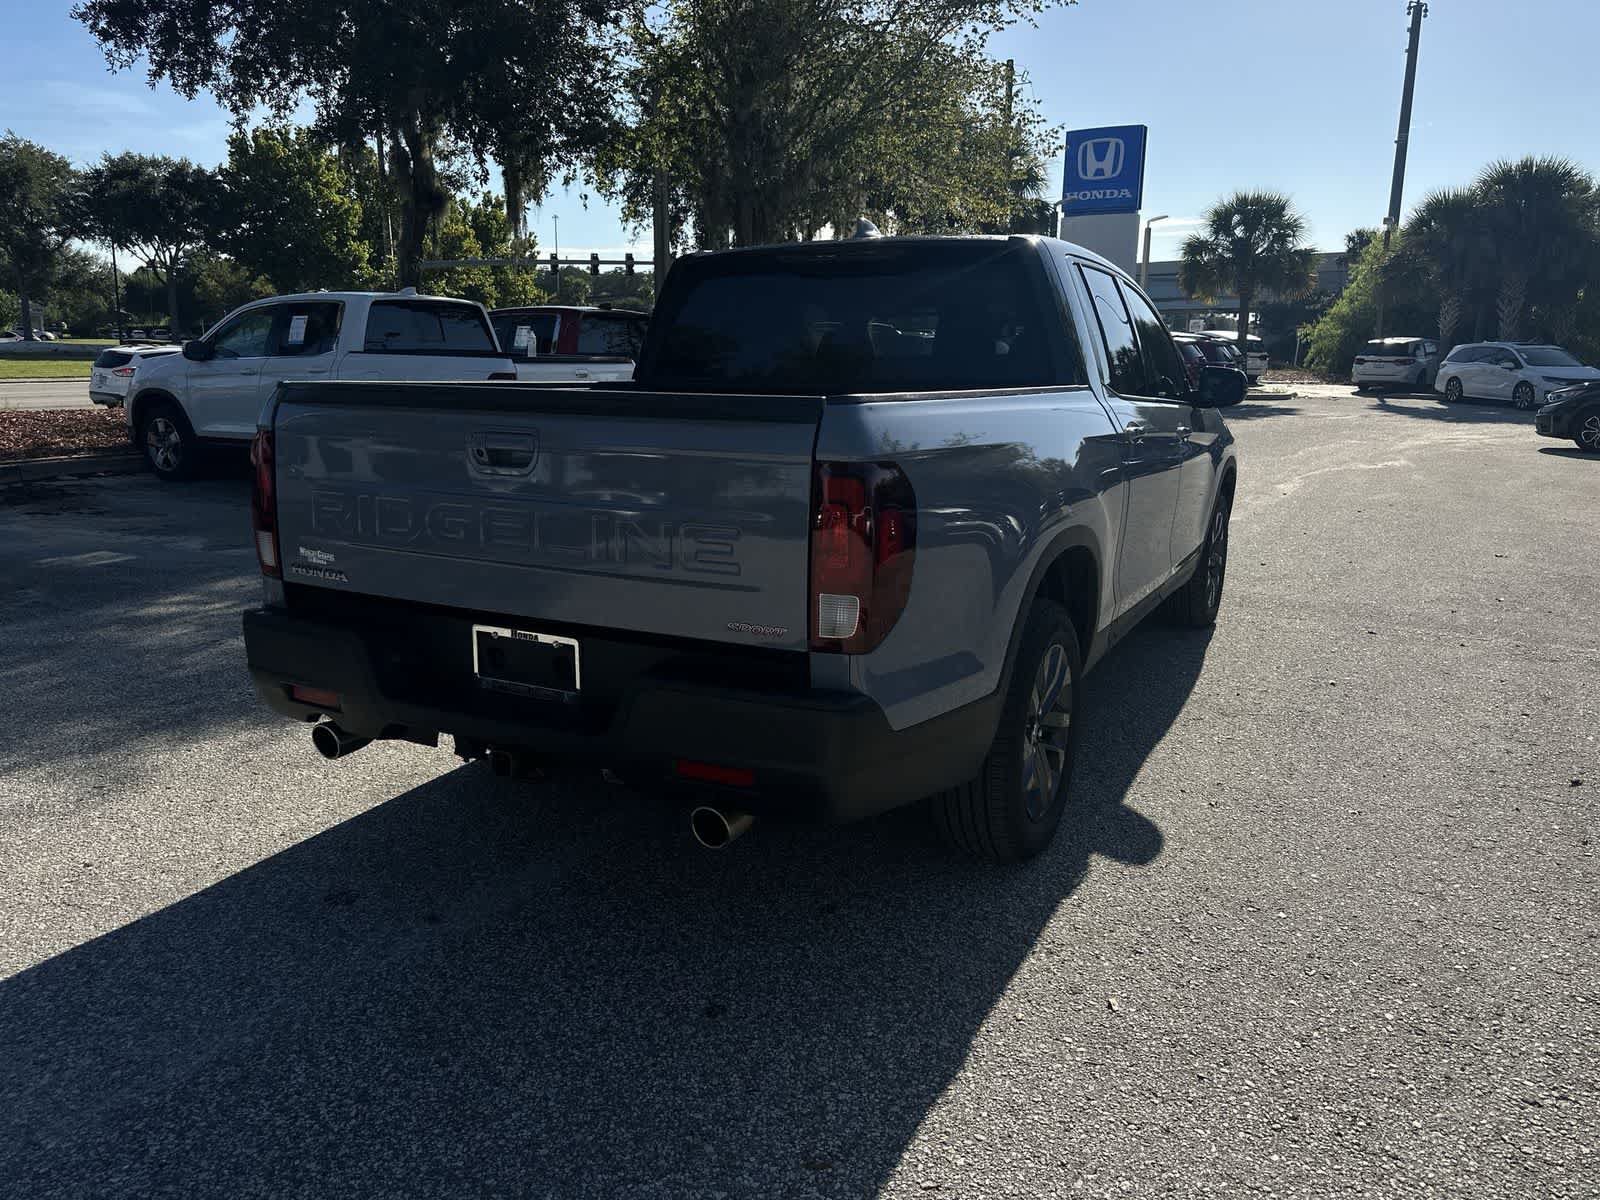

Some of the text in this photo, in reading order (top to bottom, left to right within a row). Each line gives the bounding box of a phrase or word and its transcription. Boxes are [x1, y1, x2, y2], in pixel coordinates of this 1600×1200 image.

[1064, 189, 1132, 201] HONDA
[310, 490, 742, 576] RIDGELINE
[291, 566, 348, 583] HONDA
[511, 629, 540, 642] HONDA
